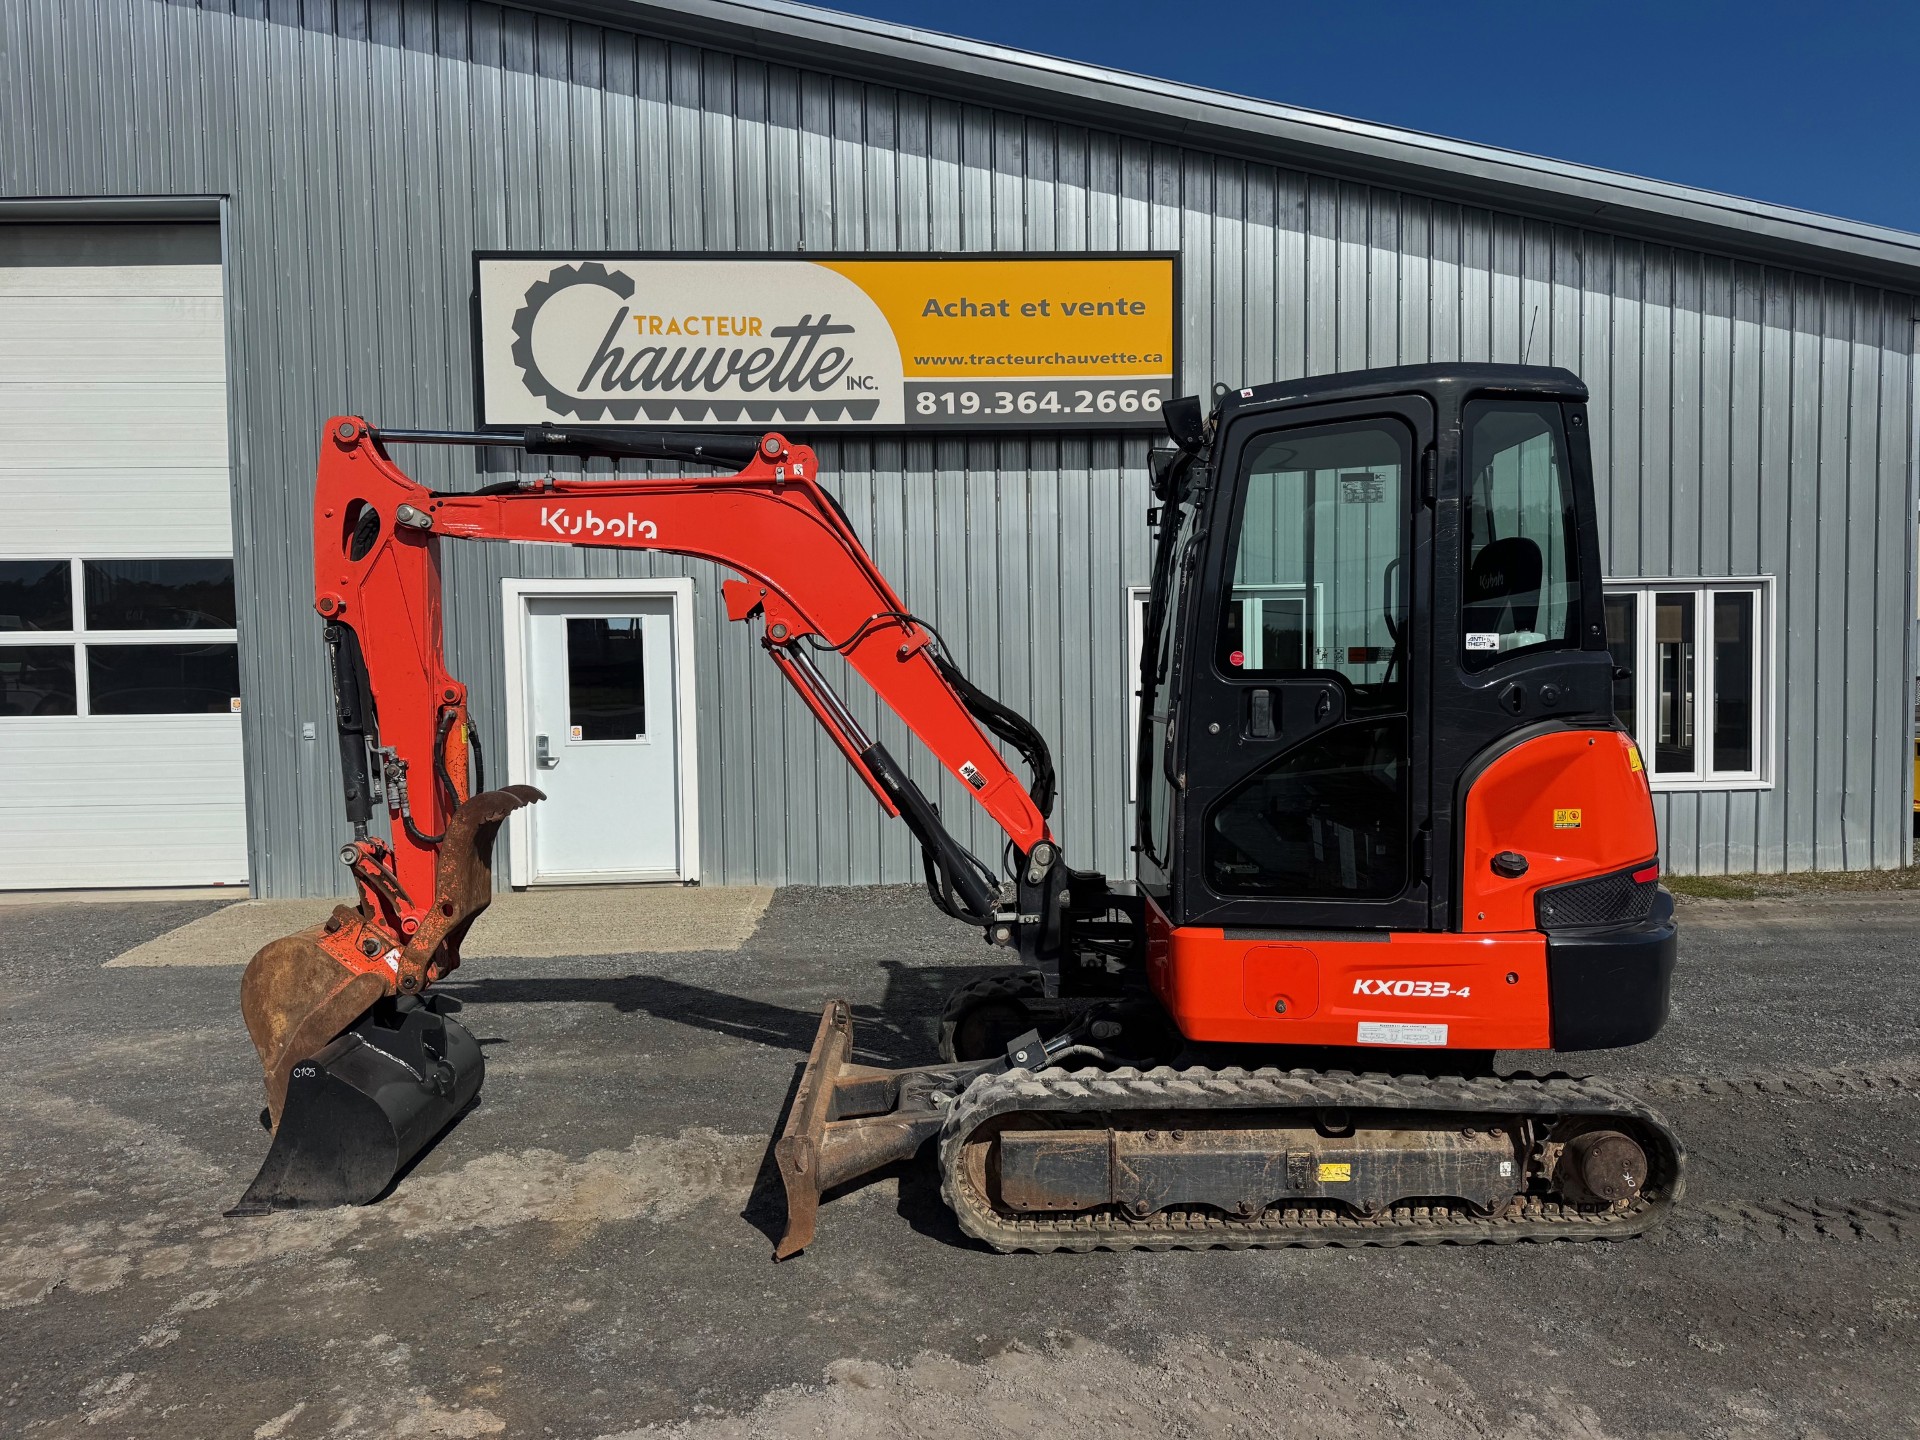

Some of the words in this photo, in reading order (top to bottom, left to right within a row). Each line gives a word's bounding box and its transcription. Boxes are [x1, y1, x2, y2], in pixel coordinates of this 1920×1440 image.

[922, 297, 1010, 317] Achat
[1020, 298, 1051, 317] et
[1061, 297, 1146, 316] vente
[633, 315, 763, 337] TRACTEUR
[913, 352, 1163, 365] www.tracteurchauvette.ca
[846, 375, 879, 391] INC.
[915, 388, 1162, 415] 819.364.2666
[541, 507, 658, 540] Kubota
[1352, 979, 1471, 998] KX033-4
